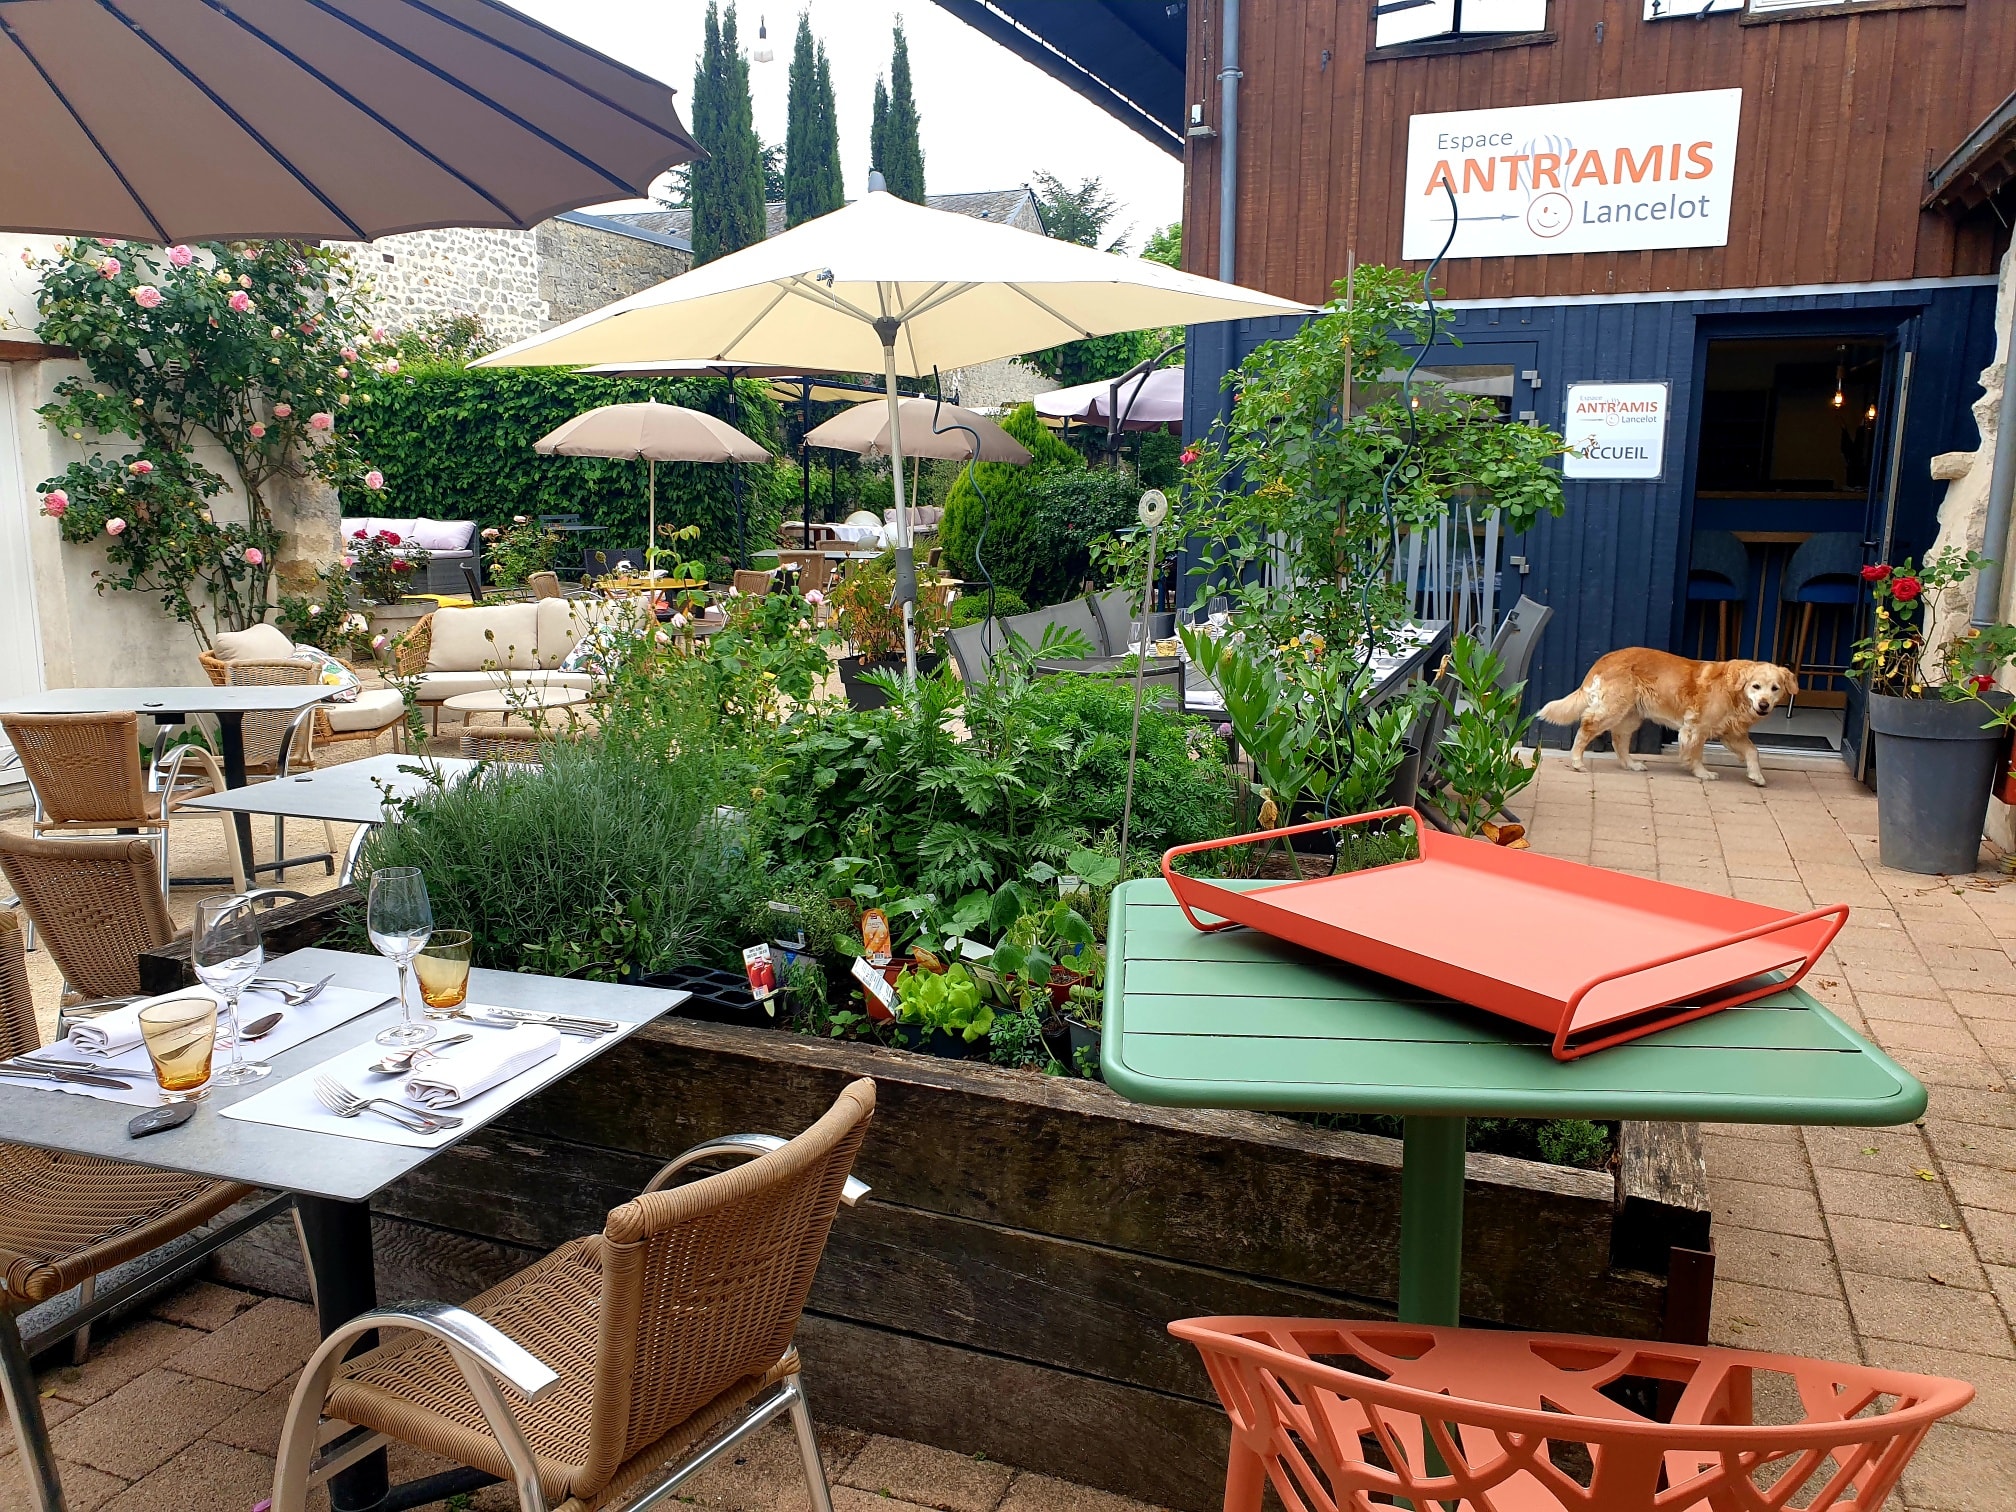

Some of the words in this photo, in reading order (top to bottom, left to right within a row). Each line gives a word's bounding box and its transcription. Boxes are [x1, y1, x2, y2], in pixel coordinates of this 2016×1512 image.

[1438, 132, 1513, 153] Espace
[1582, 194, 1711, 225] Lancelot
[1621, 415, 1657, 423] Lancelot
